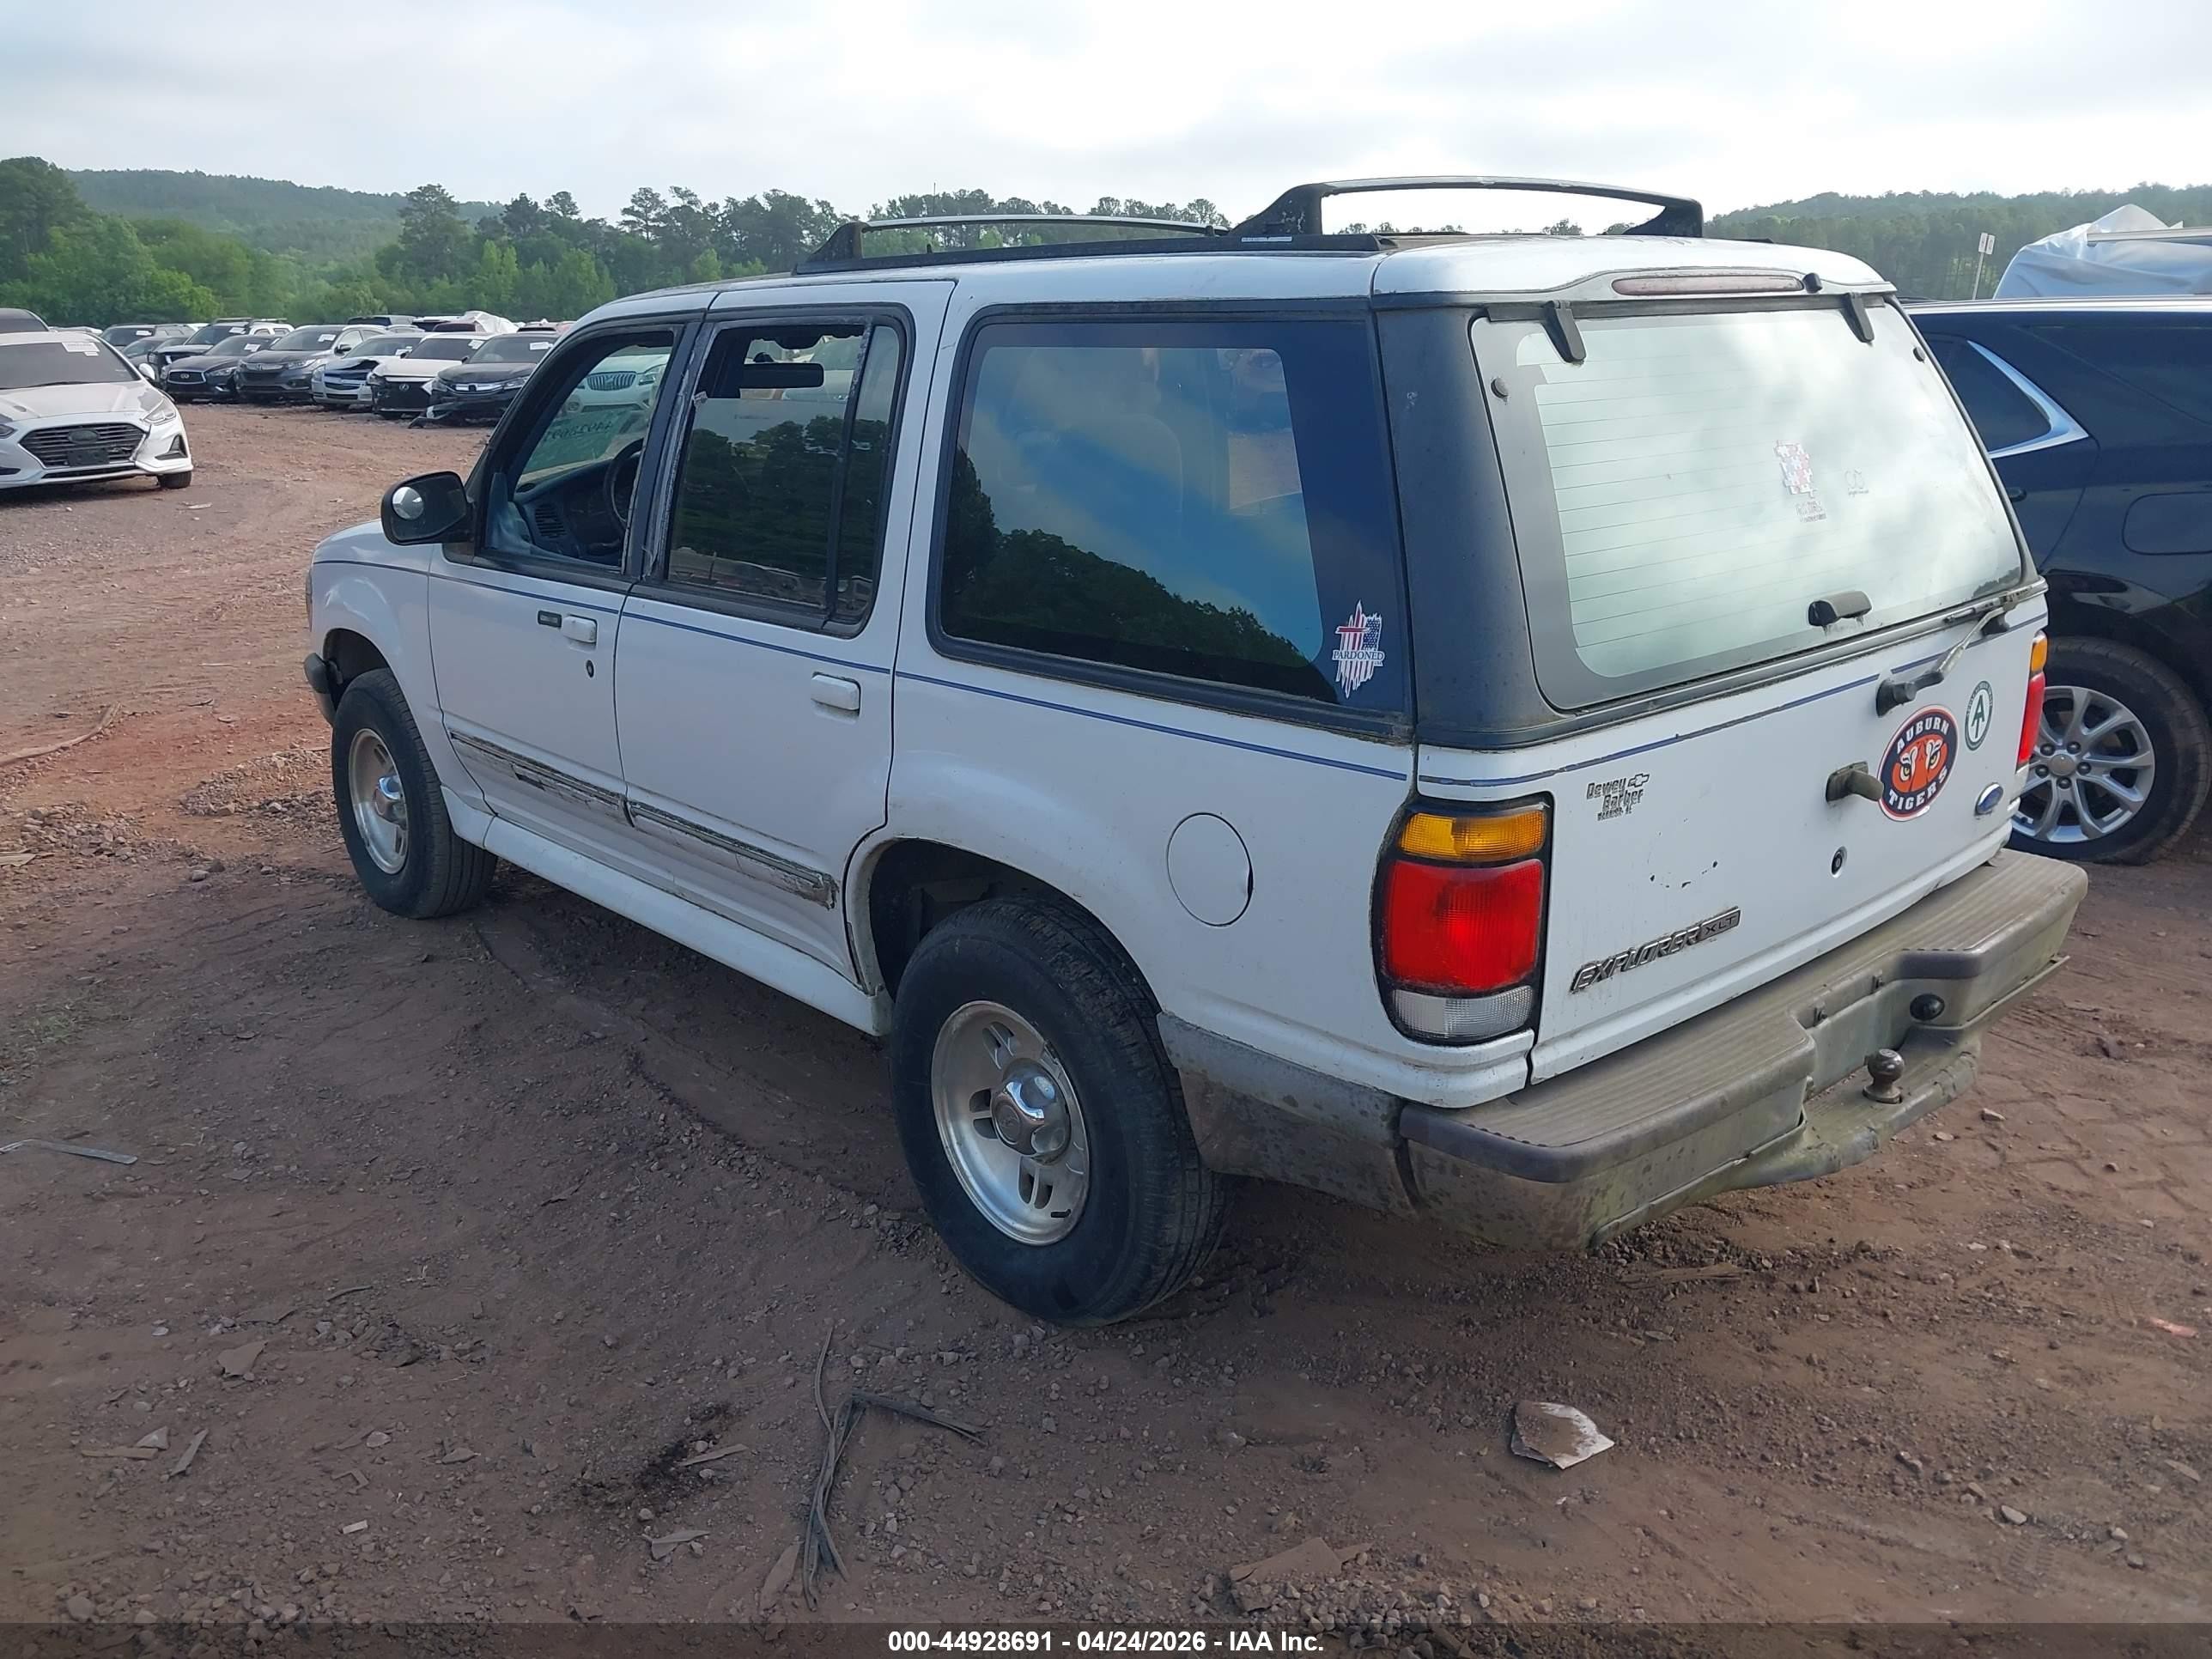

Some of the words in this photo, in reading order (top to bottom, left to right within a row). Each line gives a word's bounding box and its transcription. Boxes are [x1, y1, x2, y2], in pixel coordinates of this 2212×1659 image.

[1334, 651, 1384, 660] PARDONED
[1897, 716, 1950, 754] AUBURN
[1586, 778, 1627, 799] Dewey
[1602, 789, 1644, 812] Barber
[1889, 765, 1948, 811] TIGERS
[1570, 922, 1700, 994] EXPLORER
[1705, 915, 1738, 934] XLT
